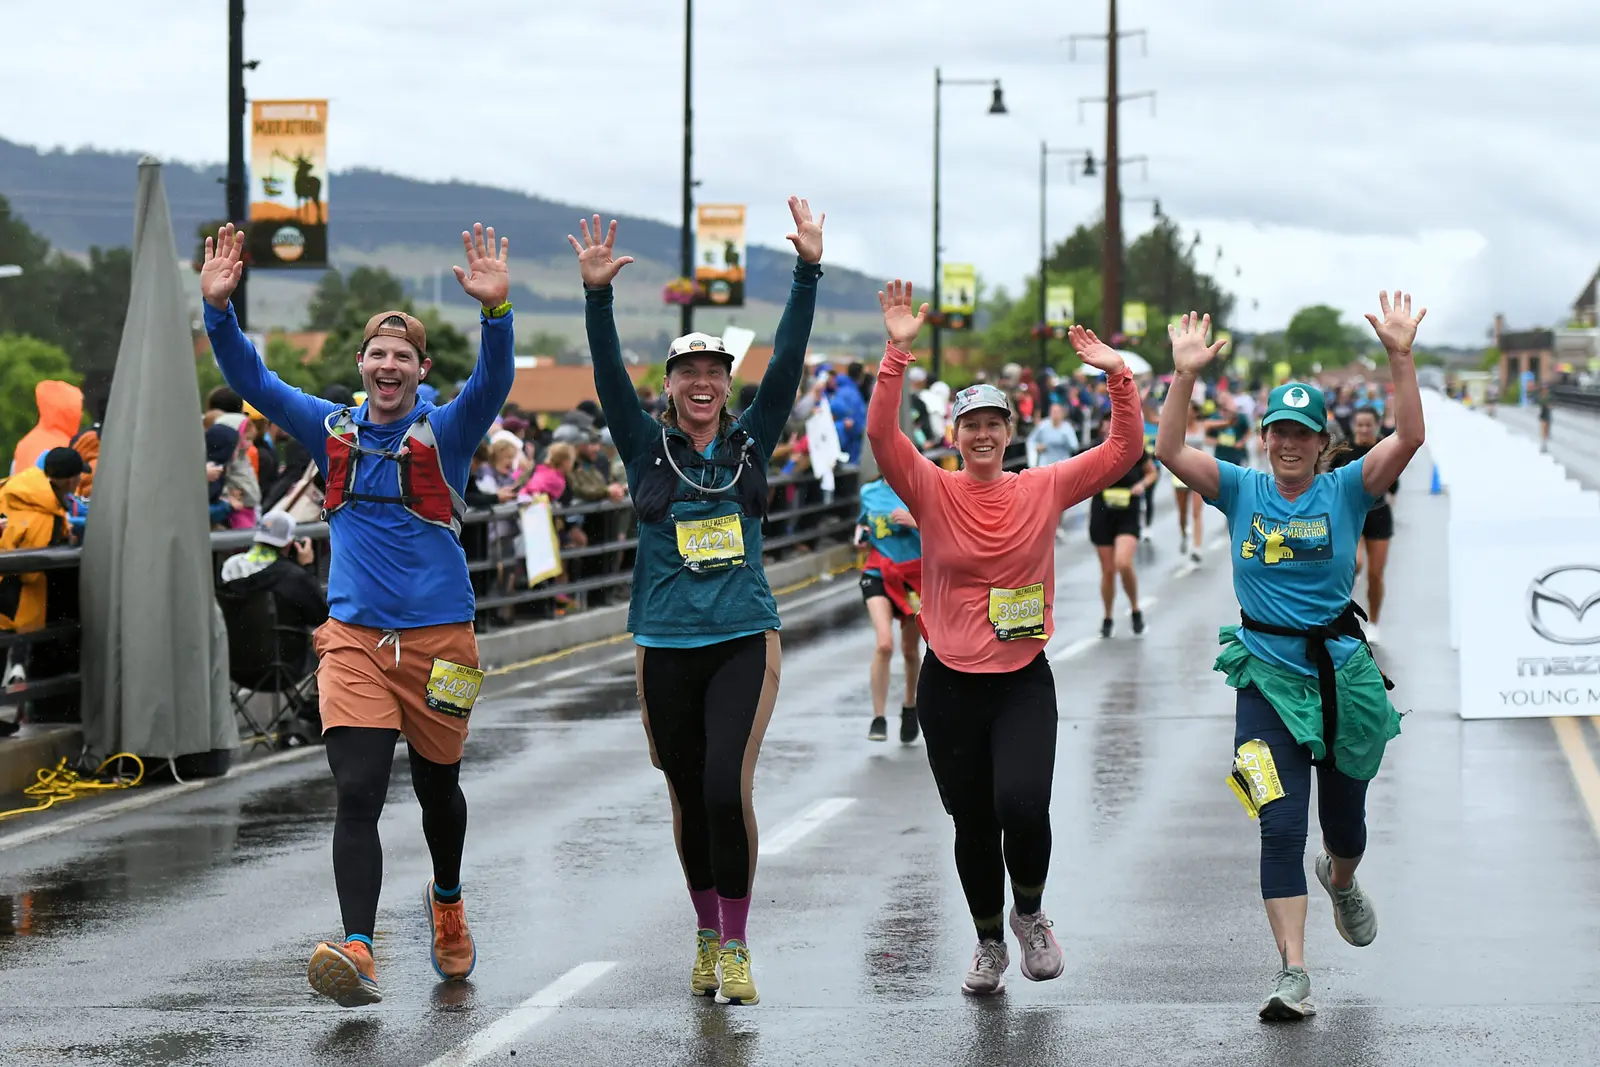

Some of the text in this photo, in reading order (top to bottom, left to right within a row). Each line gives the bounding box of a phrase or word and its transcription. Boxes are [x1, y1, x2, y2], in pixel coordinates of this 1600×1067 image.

[1287, 526, 1327, 539] MARATHON
[1312, 519, 1325, 527] HALF
[685, 529, 734, 553] 4421
[997, 598, 1040, 621] 3958
[1517, 655, 1600, 677] maz
[434, 675, 477, 699] 4420
[1499, 688, 1580, 706] YOUNG
